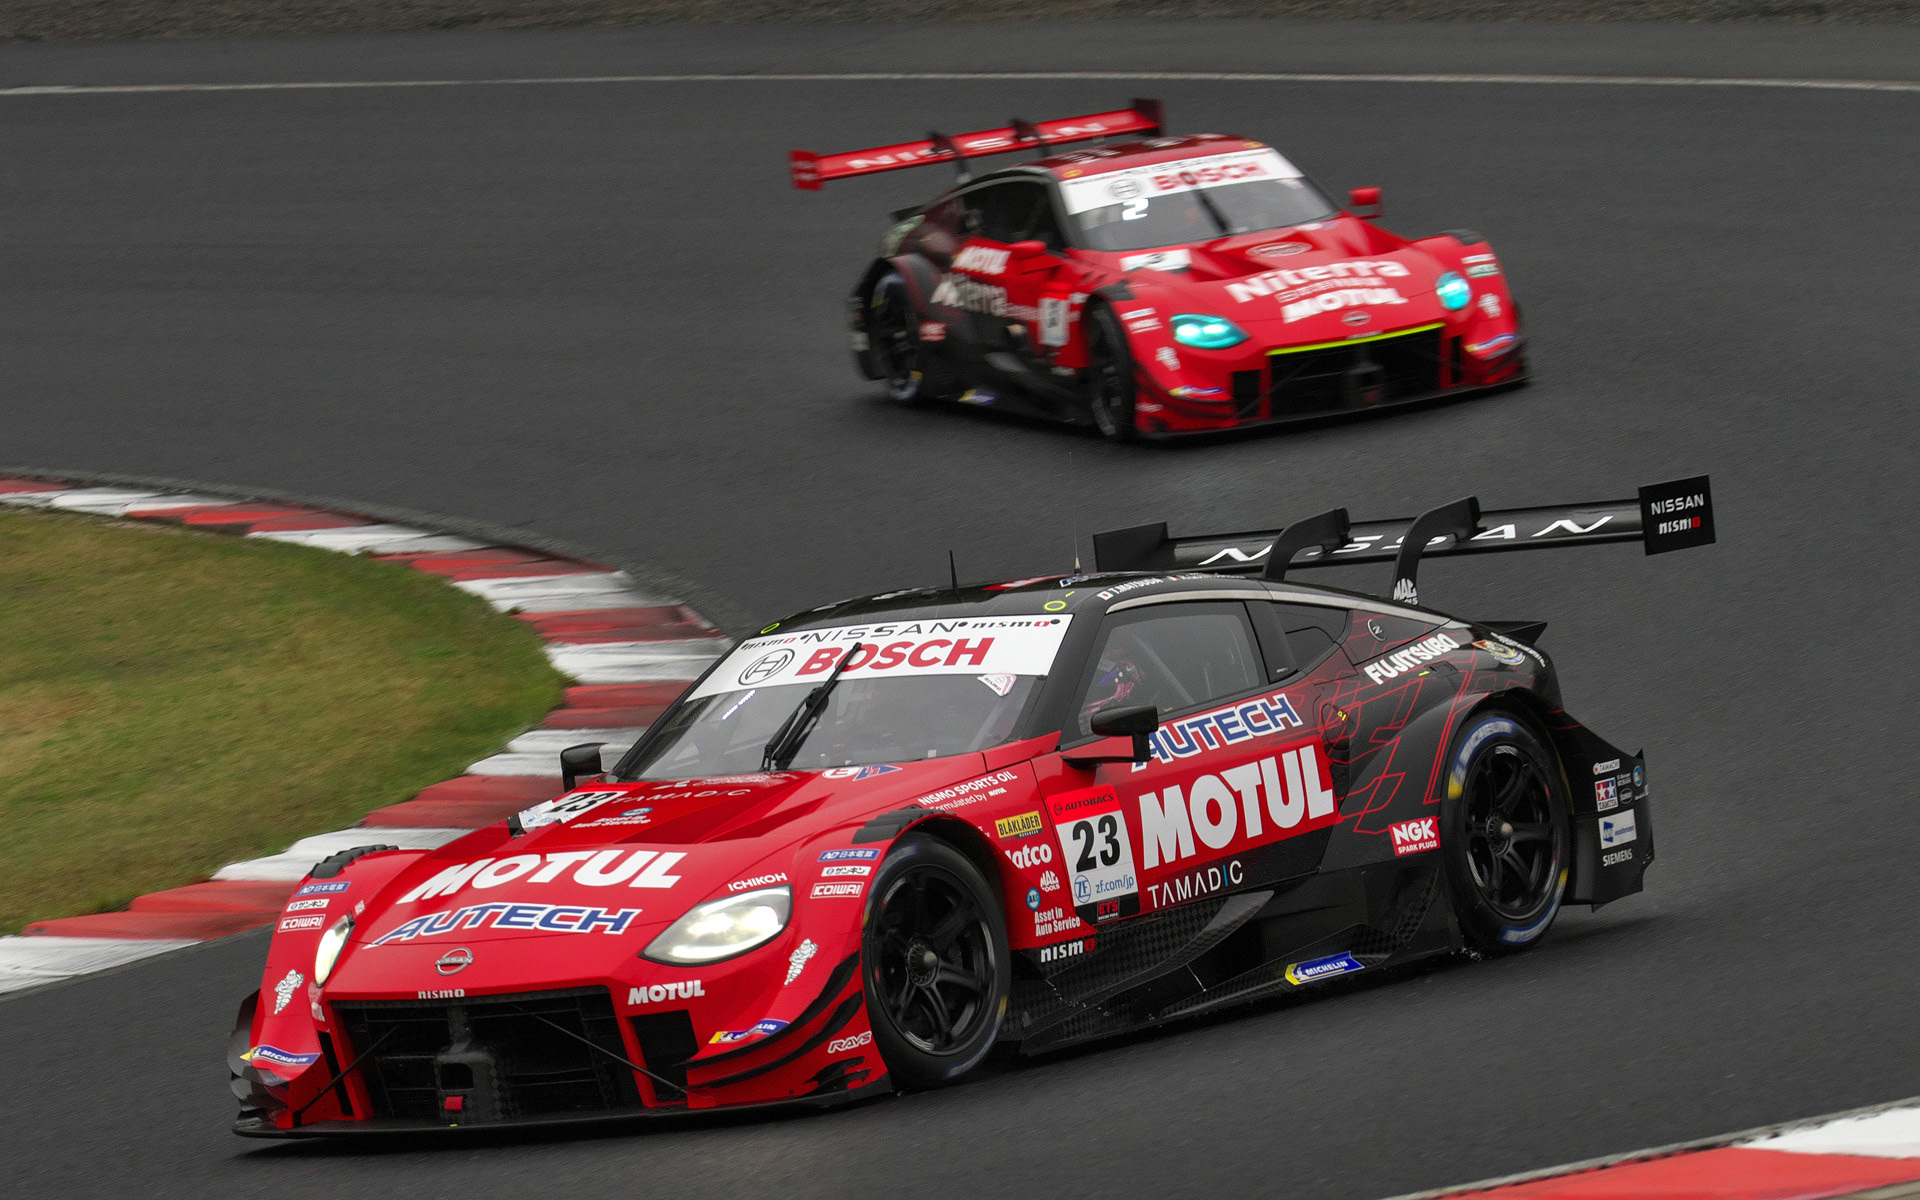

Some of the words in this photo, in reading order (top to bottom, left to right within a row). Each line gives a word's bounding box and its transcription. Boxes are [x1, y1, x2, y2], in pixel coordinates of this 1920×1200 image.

[1223, 261, 1411, 303] Niterra
[1651, 493, 1704, 515] NISSAN
[1659, 516, 1702, 535] nismo
[804, 621, 958, 644] NISSAN
[972, 621, 1050, 629] nismo
[794, 637, 995, 677] BOSCH
[1363, 633, 1460, 685] FUJITSUBO
[1131, 693, 1303, 773] AUTECH
[918, 789, 957, 806] NISMO
[954, 775, 999, 795] SPORTS
[996, 771, 1018, 783] OIL
[974, 792, 988, 802] by
[1065, 793, 1115, 811] AUTOBACS
[1139, 744, 1334, 870] MOTUL
[998, 814, 1041, 836] BLÅKLÄDER
[1392, 818, 1436, 845] NGK
[1072, 814, 1121, 873] 23
[1398, 843, 1418, 854] SPARK
[1418, 840, 1437, 850] PLUGS
[1602, 849, 1633, 867] SIEMENS
[396, 850, 687, 905] MOTUL
[728, 872, 788, 892] ICHIKOH
[1041, 870, 1060, 886] MAC
[1096, 874, 1135, 895] zf.com/jp
[1147, 860, 1243, 910] TAMADIC
[814, 884, 861, 896] KOIWAI
[1075, 880, 1091, 899] ZF
[281, 916, 323, 930] KOIWAI
[362, 901, 642, 949] AUTECH
[1034, 908, 1055, 924] Asset
[1055, 907, 1063, 920] in
[1036, 921, 1053, 937] Auto
[1053, 916, 1081, 933] Service
[1041, 938, 1096, 963] nismo
[1305, 960, 1348, 976] MICHELIN
[418, 988, 465, 1000] nismo
[628, 979, 705, 1005] MOTUL
[828, 1031, 872, 1053] RAYS
[261, 1049, 309, 1063] MICHELIN
